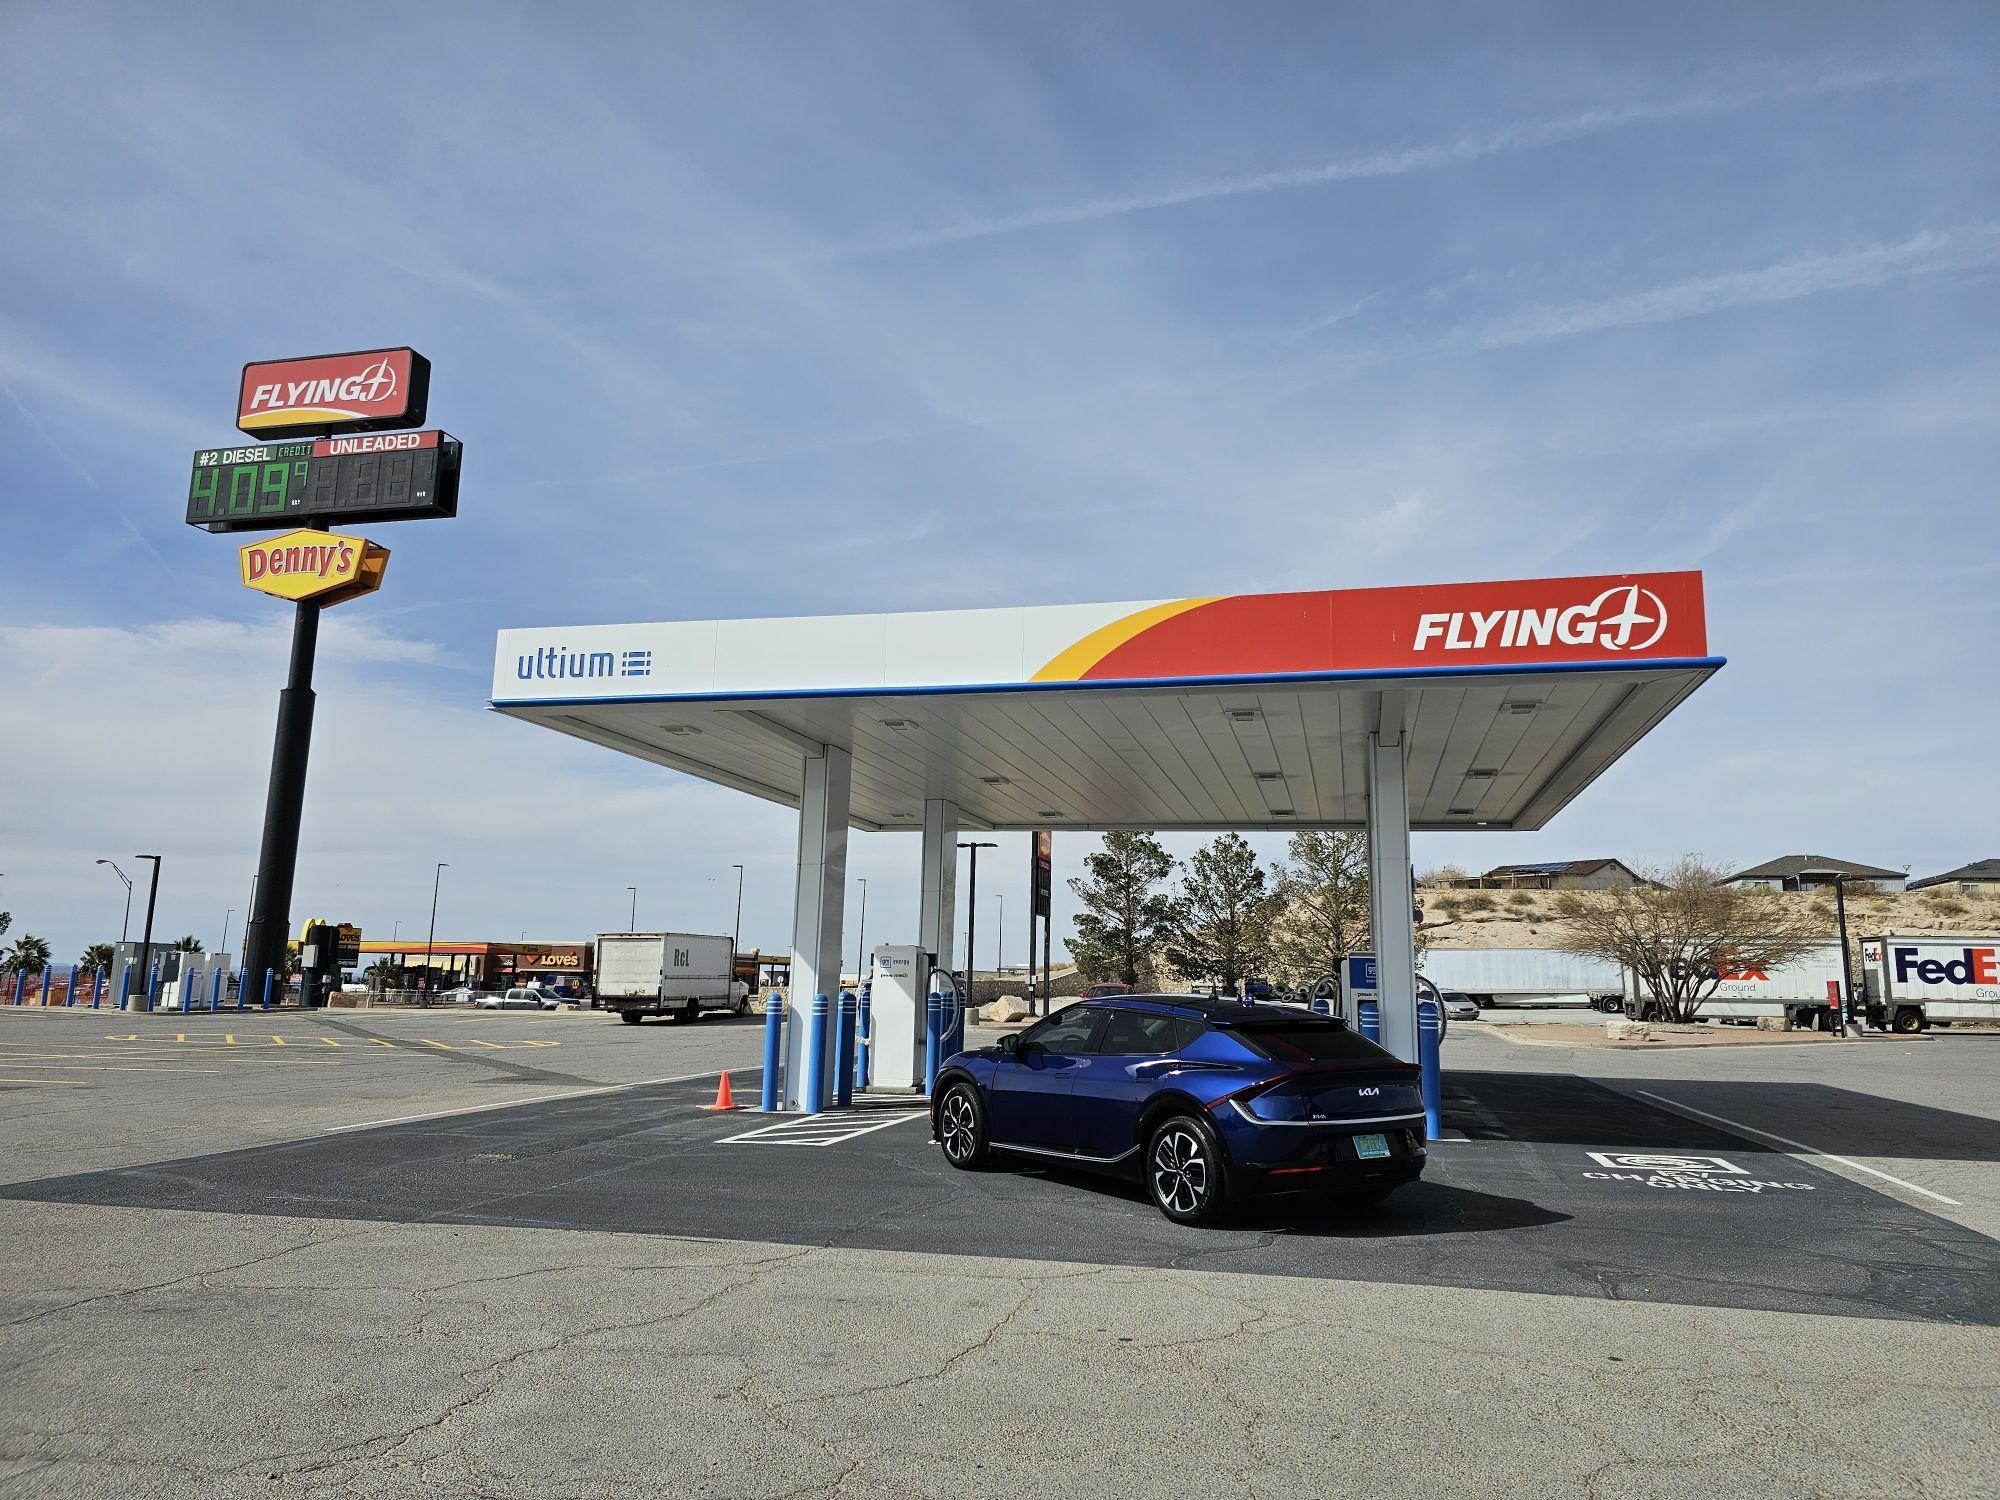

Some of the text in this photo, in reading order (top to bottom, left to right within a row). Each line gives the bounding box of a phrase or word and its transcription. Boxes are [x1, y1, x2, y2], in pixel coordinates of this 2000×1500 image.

[250, 375, 362, 409] FLYING
[200, 447, 271, 466] #2 DIESEL
[279, 445, 312, 457] CREDIT
[329, 434, 420, 455] UNLEADED
[248, 540, 354, 581] Denny's
[1412, 604, 1600, 651] FLYING
[517, 646, 615, 679] ultium
[1894, 947, 2000, 985] FedE
[1720, 982, 1756, 993] Ground
[1359, 1087, 1380, 1096] KIA
